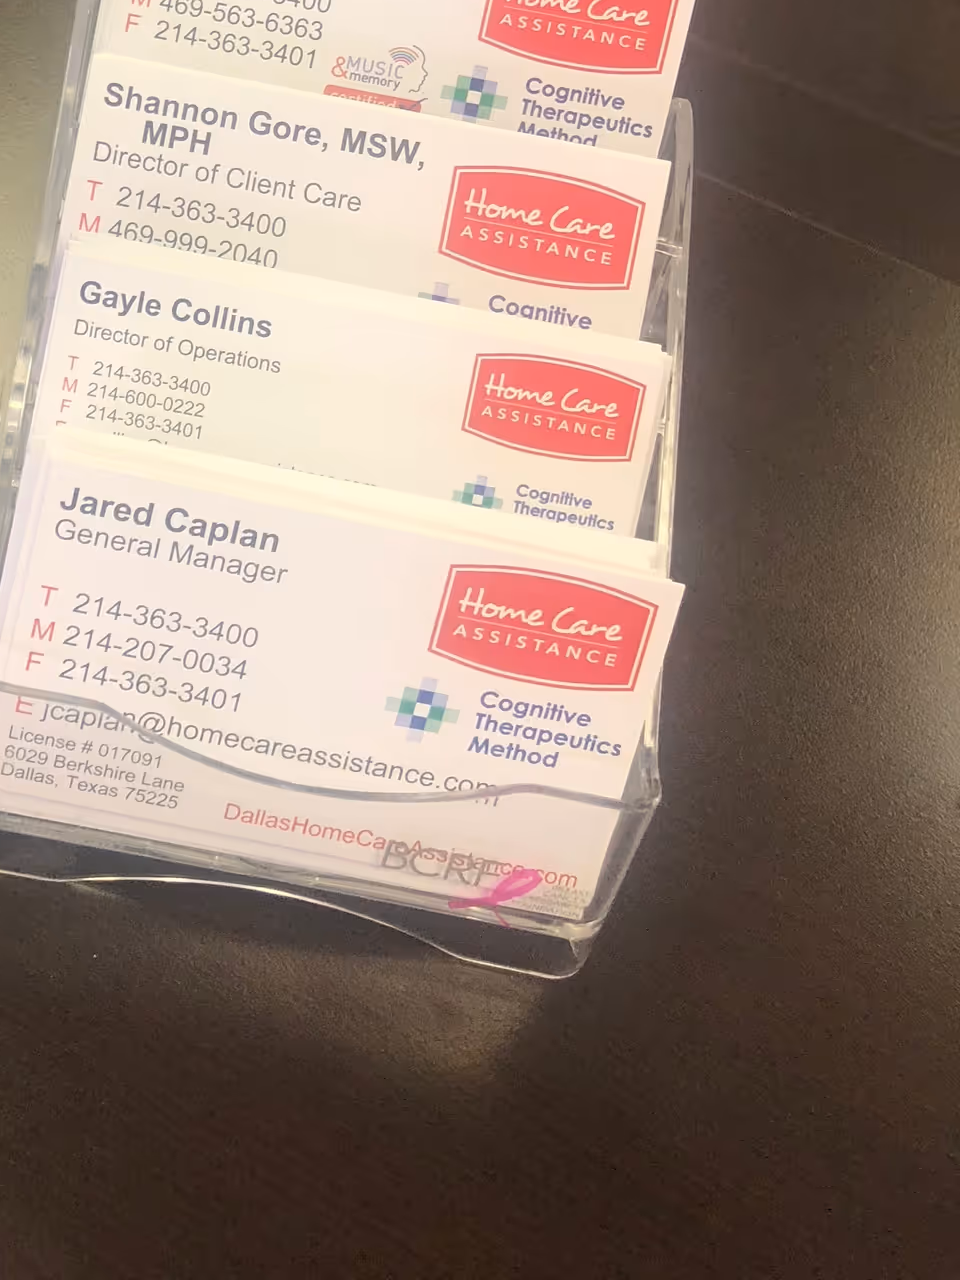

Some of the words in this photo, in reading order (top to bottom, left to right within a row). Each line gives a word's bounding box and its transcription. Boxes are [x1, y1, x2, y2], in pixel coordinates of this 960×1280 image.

[125, 14, 142, 32] F
[154, 21, 317, 69] 214-363-3401
[499, 13, 647, 51] ASSISTANCE
[349, 72, 401, 91] memory
[525, 77, 625, 110] Cognitive
[104, 83, 239, 130] Shannon
[249, 110, 328, 151] Gore,
[340, 128, 425, 171] MSW,
[141, 120, 212, 156] MPH
[521, 98, 653, 138] Therapeutics
[93, 141, 189, 178] Director
[195, 164, 221, 184] of
[226, 168, 296, 199] Client
[304, 182, 362, 211] Care
[87, 179, 103, 201] T
[116, 186, 287, 237] 214-363-3400
[464, 188, 543, 226] Home
[549, 206, 616, 240] Care
[78, 213, 101, 234] M
[108, 219, 278, 268] 469-999-2040
[460, 225, 613, 266] ASSISTANCE
[79, 280, 161, 317] Gayle
[172, 298, 272, 338] Collins
[73, 318, 149, 348] Director
[153, 336, 174, 352] of
[178, 339, 281, 373] Operations
[61, 377, 78, 393] M
[87, 382, 205, 418] 214-600-0222
[67, 355, 79, 370] T
[93, 361, 211, 396] 214-363-3400
[484, 373, 555, 406] Home
[561, 388, 619, 418] Care
[60, 399, 72, 413] F
[86, 404, 203, 439] 214-363-3401
[481, 406, 616, 441] ASSISTANCE
[513, 500, 614, 531] Therapeutics
[516, 484, 593, 510] Cognitive
[60, 487, 155, 527] Jared
[165, 508, 280, 553] Caplan
[55, 519, 160, 559] General
[168, 541, 288, 583] Manager
[41, 585, 58, 607] T
[73, 593, 258, 648] 214-363-3400
[459, 587, 544, 627] Home
[551, 607, 623, 642] Care
[30, 618, 55, 642] M
[63, 625, 248, 680] 214-207-0034
[452, 624, 617, 667] ASSISTANCE
[25, 651, 44, 672] F
[58, 658, 242, 712] 214-363-3401
[480, 691, 592, 727] Cognitive
[8, 725, 76, 751] License
[81, 740, 93, 754] #
[98, 743, 163, 768] 017091
[467, 736, 560, 768] Method
[475, 712, 622, 756] Therapeutics
[0, 762, 58, 788] Dallas,
[67, 775, 119, 798] Texas
[125, 786, 179, 809] 75225
[4, 745, 48, 766] 6029
[53, 754, 136, 783] Berkshire
[141, 772, 185, 792] Lane
[223, 803, 578, 888] DallasHomeCareAssistanceom
